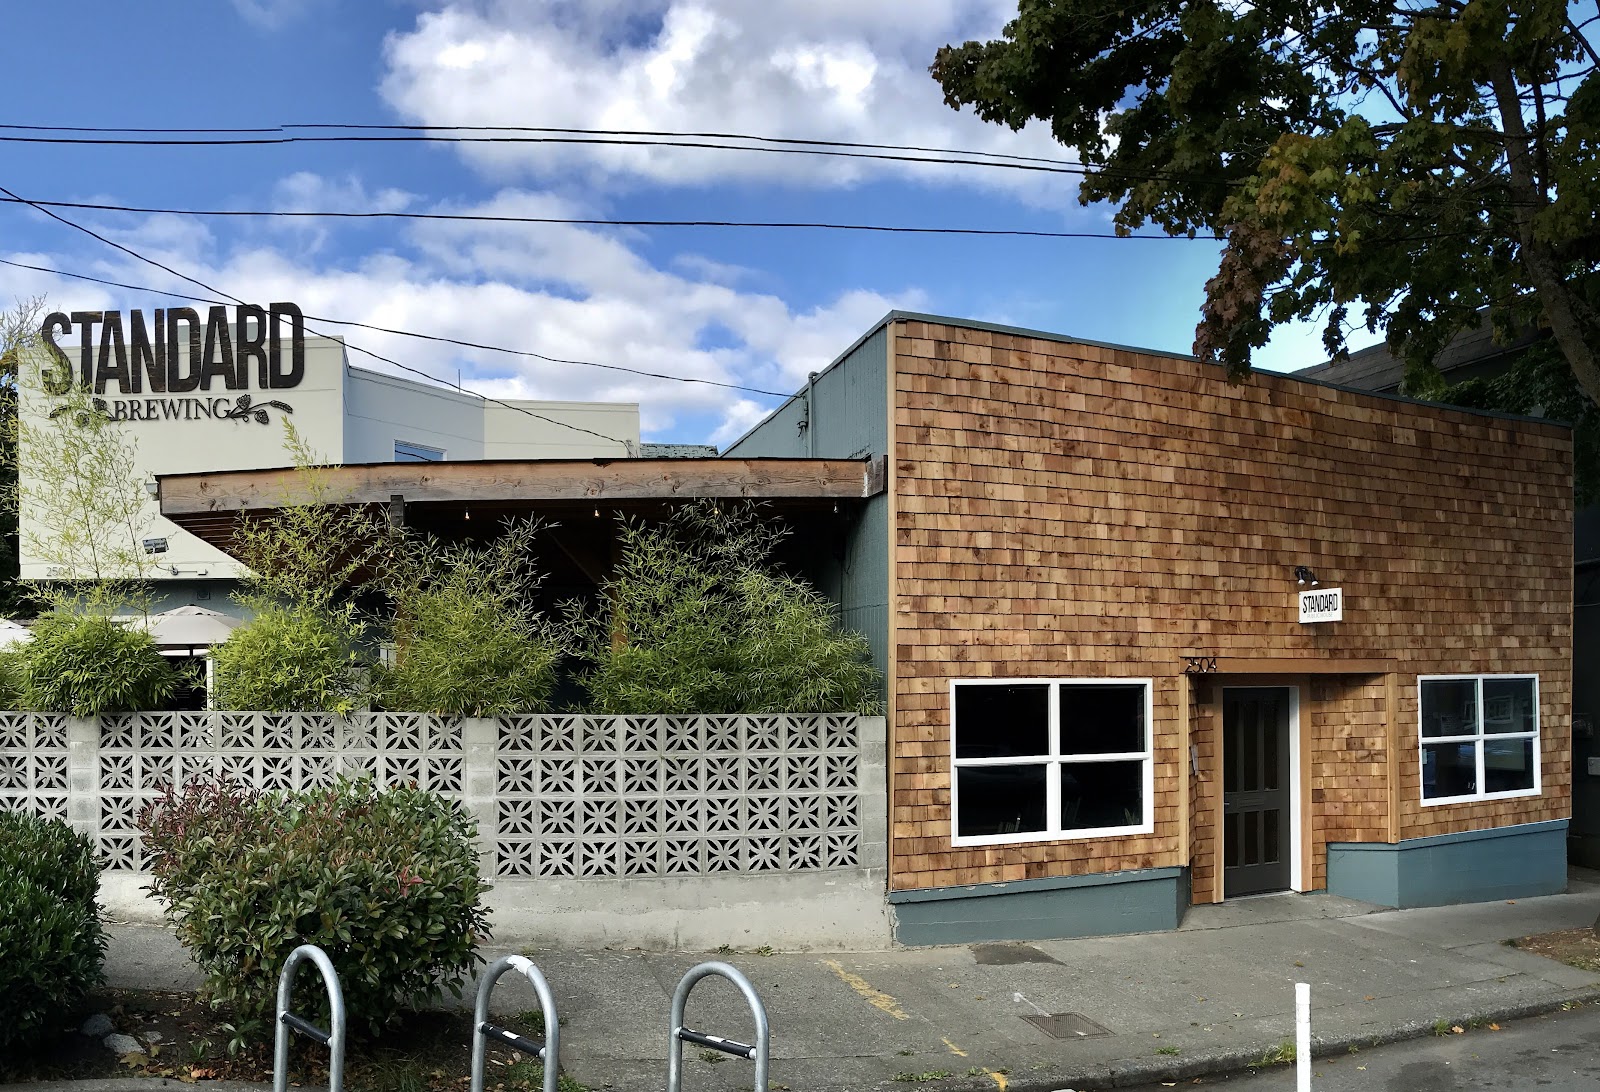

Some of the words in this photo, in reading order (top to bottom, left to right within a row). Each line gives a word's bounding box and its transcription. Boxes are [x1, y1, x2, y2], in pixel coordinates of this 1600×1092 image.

[41, 302, 305, 396] STANDARD
[112, 397, 231, 422] BREWING
[1302, 593, 1338, 614] STANDARD
[1184, 657, 1217, 673] 2504
